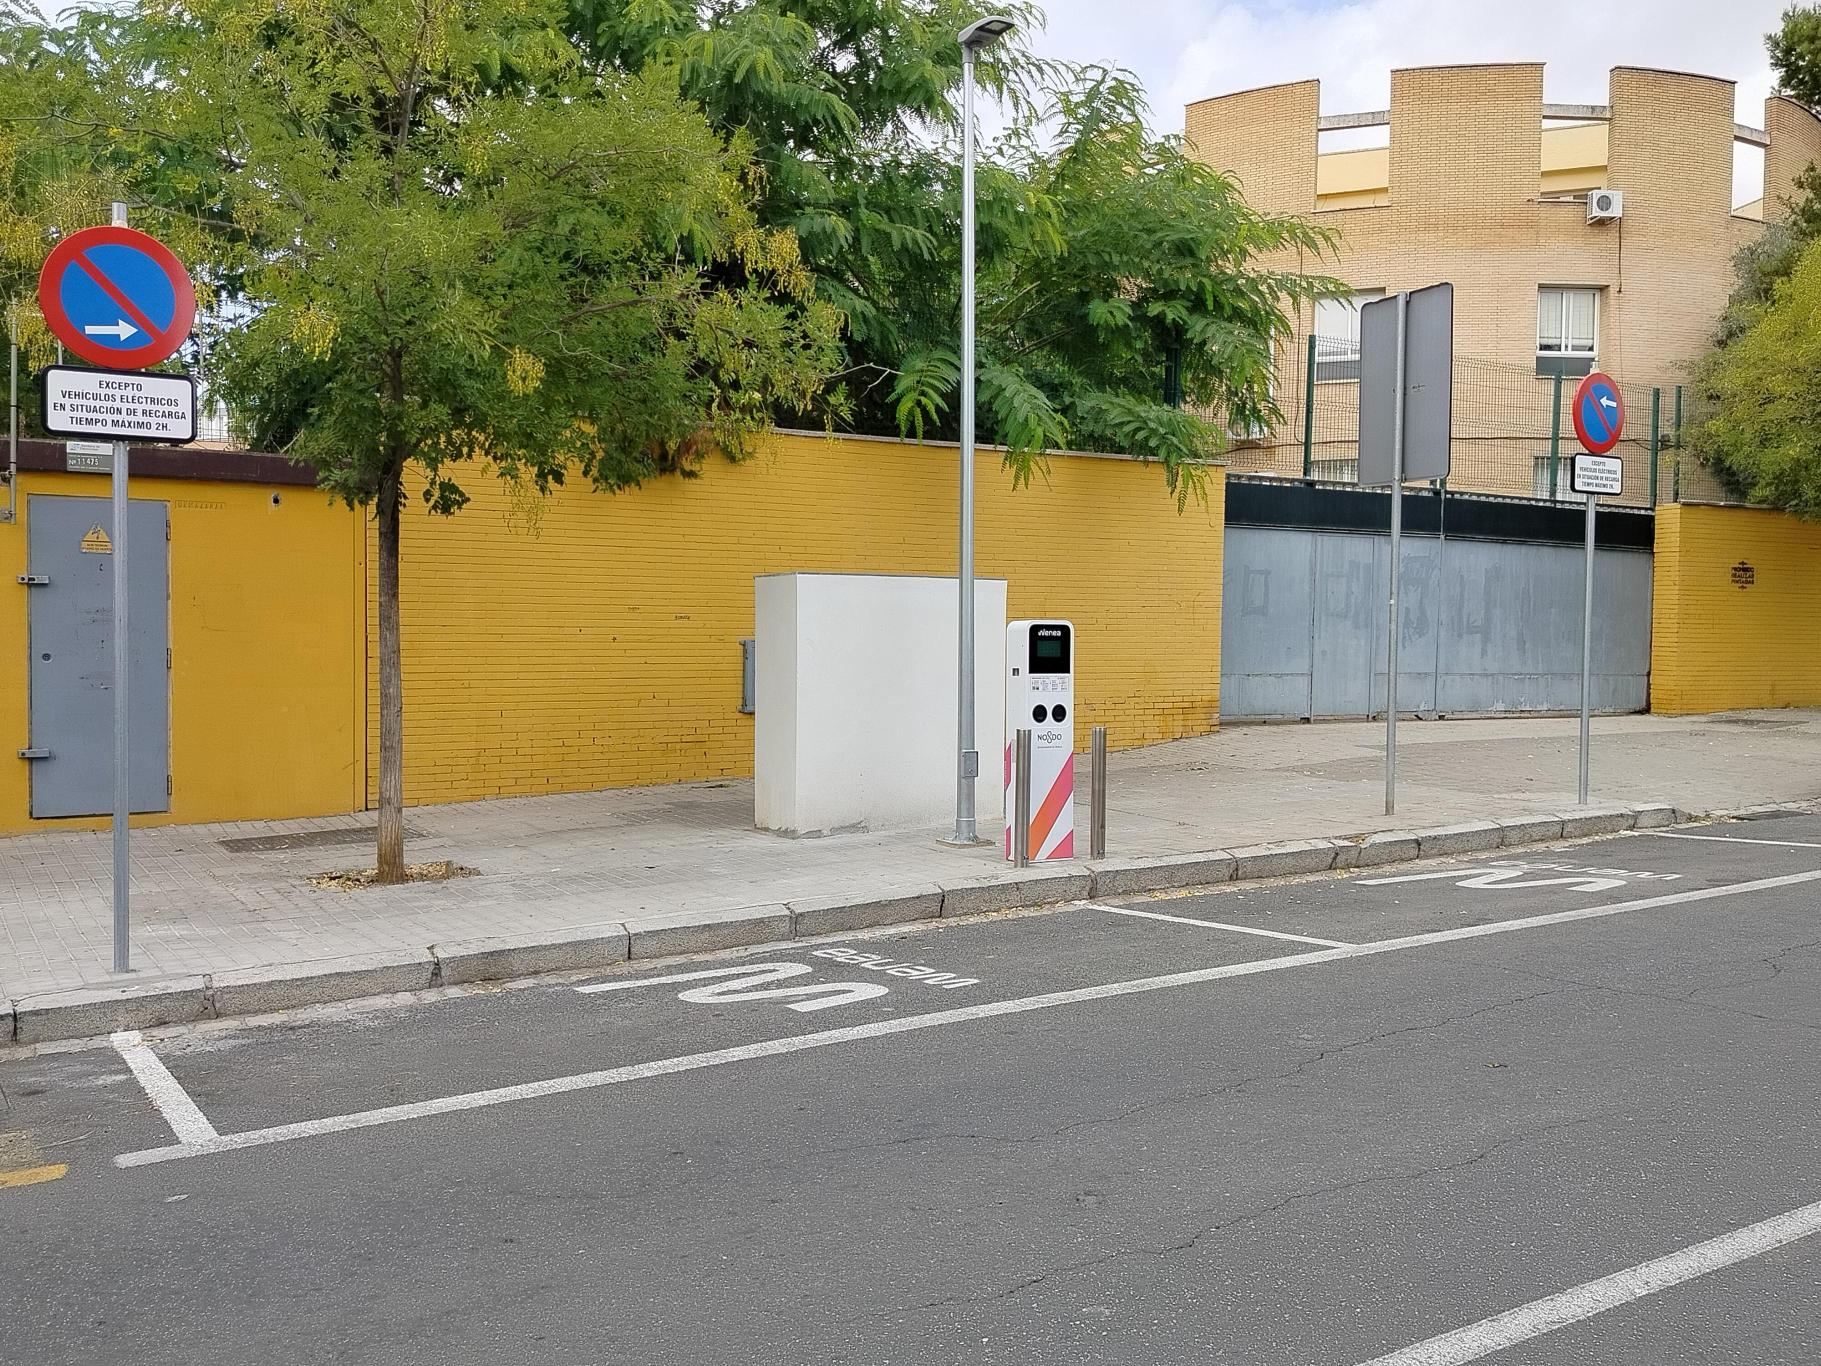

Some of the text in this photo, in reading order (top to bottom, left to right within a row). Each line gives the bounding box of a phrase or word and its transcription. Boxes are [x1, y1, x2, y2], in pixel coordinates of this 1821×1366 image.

[98, 380, 143, 392] EXCEPTO
[60, 389, 179, 408] VEHÍCULOS ELÉCTRICOS
[53, 402, 187, 420] EN SITUACIÓN DE RECARGA
[69, 416, 171, 431] TIEMPO MÁXIMO 2H.
[77, 458, 99, 466] 11475
